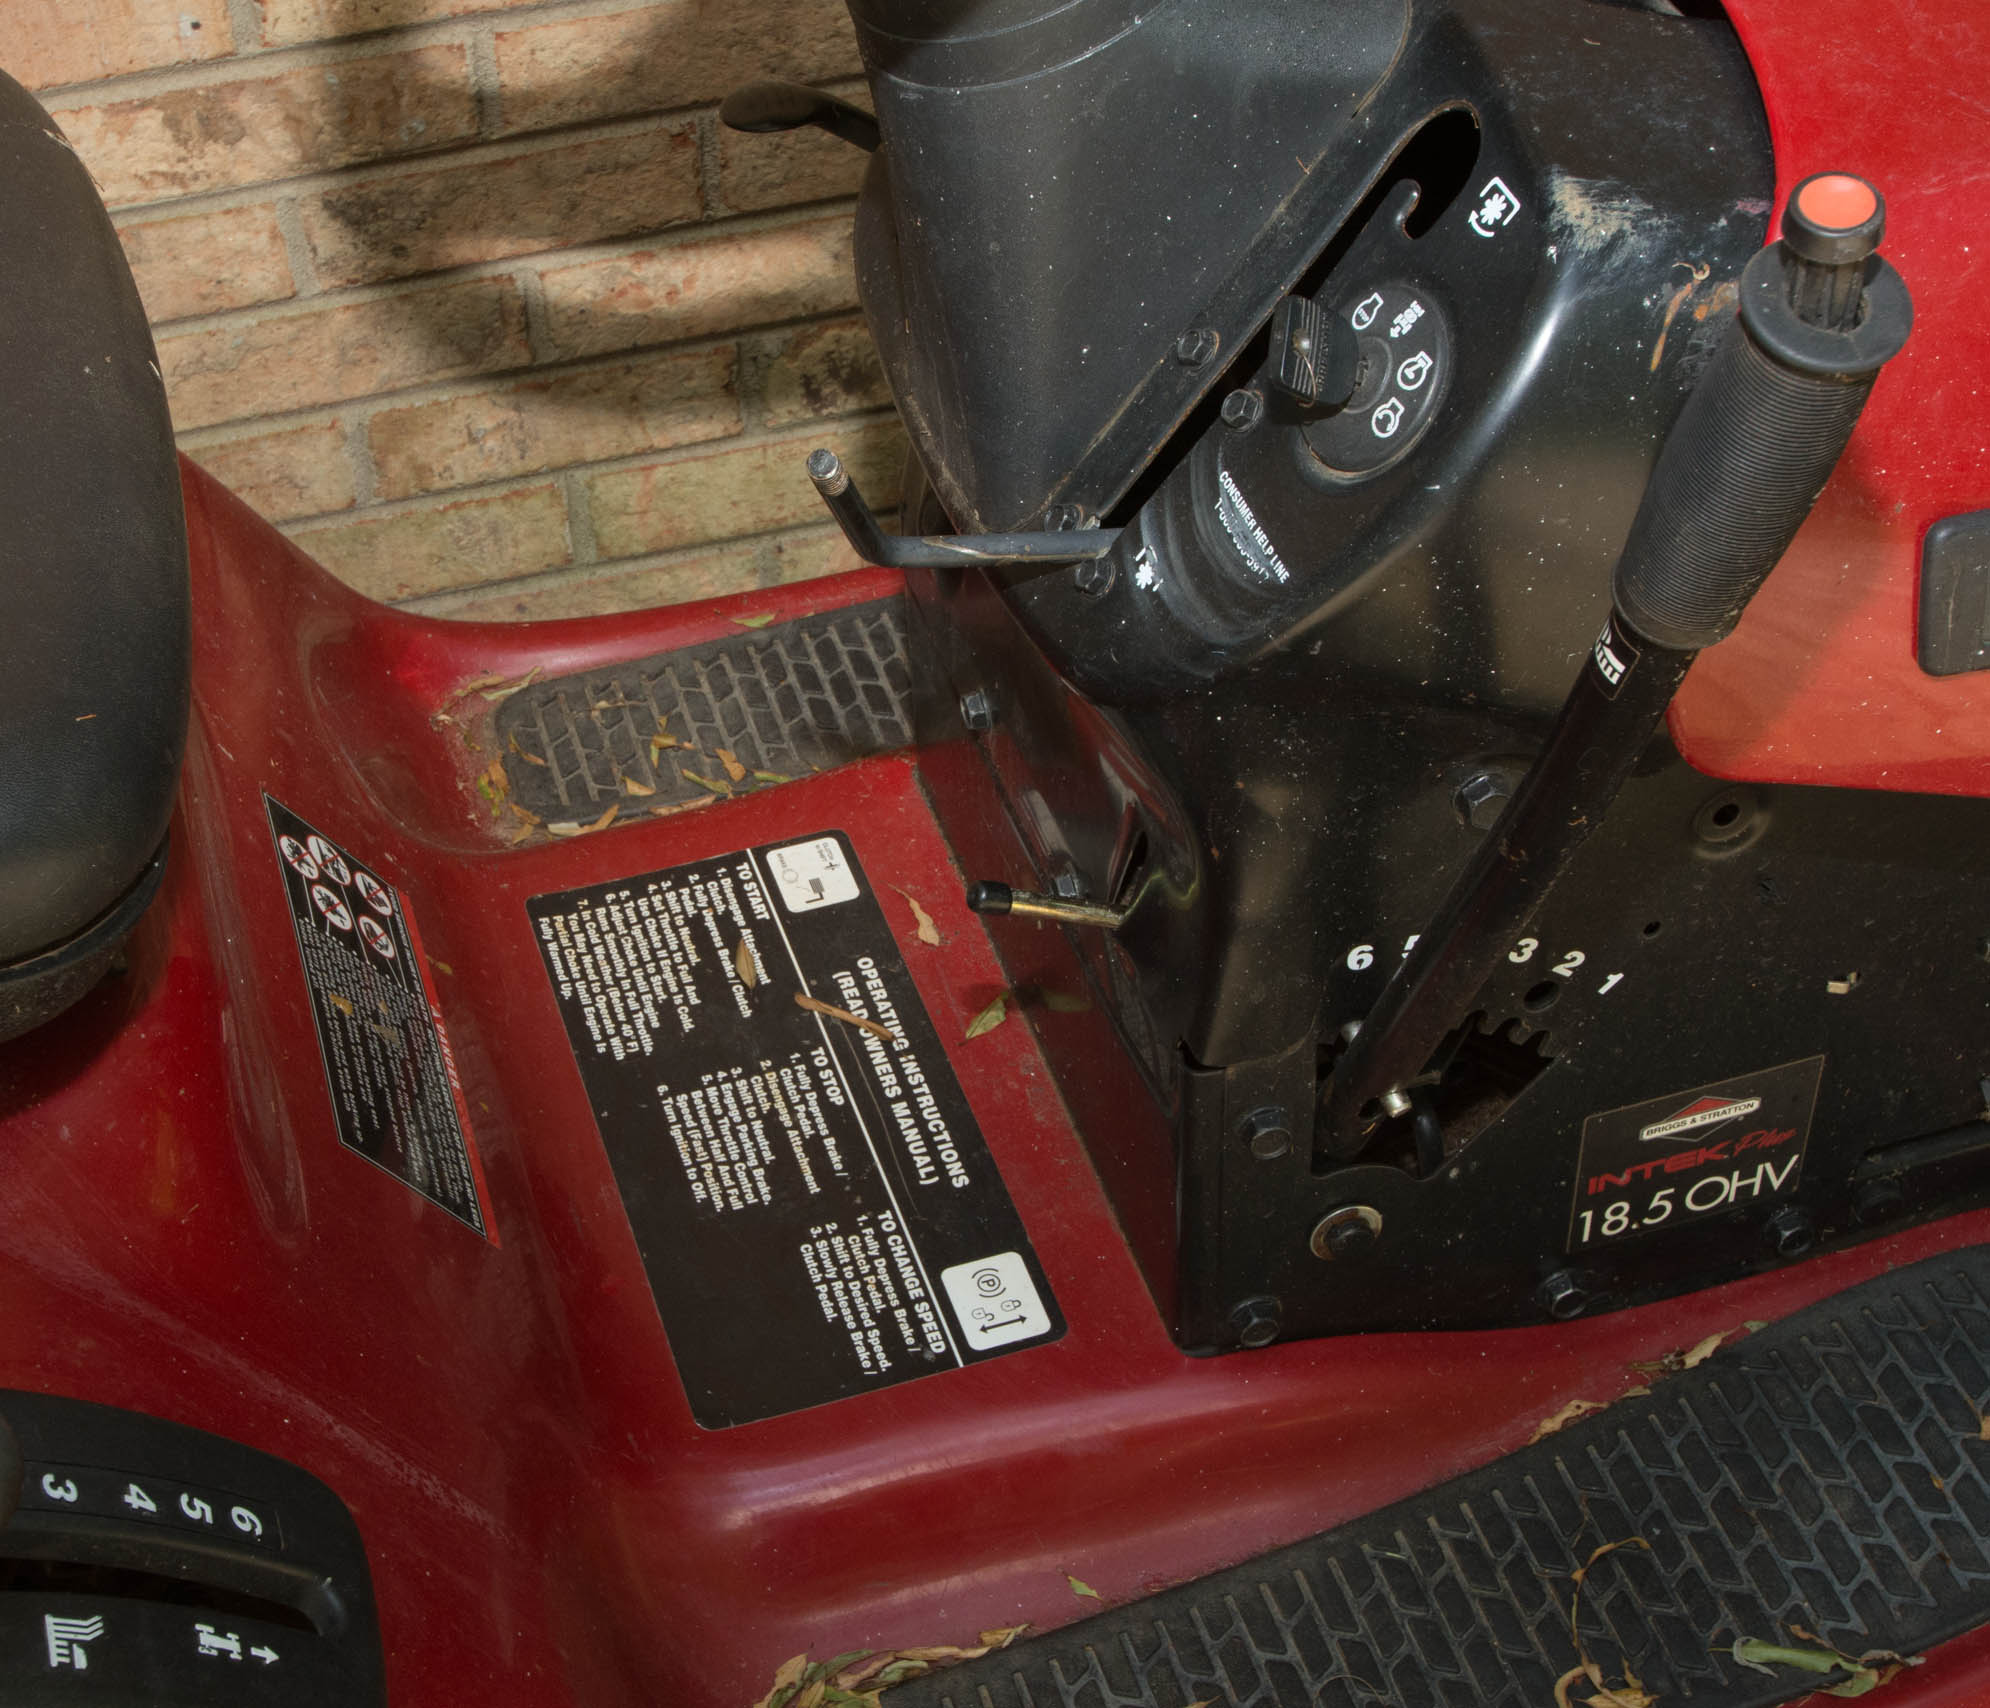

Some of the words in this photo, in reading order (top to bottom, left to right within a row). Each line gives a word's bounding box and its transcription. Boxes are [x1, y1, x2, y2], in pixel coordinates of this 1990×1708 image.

[1219, 471, 1257, 530] CONSUMER
[1253, 526, 1274, 555] HELP
[1270, 554, 1290, 584] LINE
[660, 880, 671, 890] 3.
[688, 873, 699, 883] 2.
[716, 867, 726, 877] 1.
[735, 861, 752, 880] TO
[605, 893, 616, 903] 6.
[618, 890, 630, 900] 5.
[647, 884, 657, 893] 4.
[650, 894, 665, 911] Set
[664, 890, 681, 914] Shift
[678, 887, 697, 917] Pedal.
[692, 884, 708, 907] Fully
[706, 880, 726, 915] Clutch.
[719, 877, 745, 926] Disengage
[743, 881, 770, 919] START
[577, 899, 588, 909] 7.
[580, 910, 591, 920] In
[594, 907, 609, 931] Runs
[623, 900, 637, 923] Turn
[636, 897, 650, 916] Use
[567, 912, 579, 932] You
[585, 921, 601, 944] Cold
[608, 905, 628, 935] Adjust
[644, 917, 662, 948] Choke
[657, 911, 679, 950] Throttle
[673, 914, 684, 926] to
[701, 908, 723, 947] Depress
[573, 933, 587, 952] May
[603, 932, 627, 977] Smoothly
[620, 935, 637, 966] Choke
[630, 924, 651, 961] Ignition
[655, 949, 668, 957] If
[672, 951, 682, 963] to
[678, 926, 700, 966] Neutral.
[740, 928, 771, 984] Attachment
[538, 917, 553, 940] Fully
[546, 941, 569, 981] Warmed
[560, 982, 572, 999] Up.
[581, 954, 599, 980] Need
[593, 944, 613, 985] Weather
[645, 962, 655, 973] to
[717, 948, 735, 978] Brake
[1347, 944, 1374, 971] 6
[1508, 937, 1539, 964] 3
[1551, 950, 1586, 977] 2
[1598, 972, 1625, 995] 1
[552, 915, 572, 946] Partial
[564, 948, 580, 978] Choke
[574, 980, 592, 1004] Until
[583, 1006, 601, 1040] Engine
[595, 1042, 606, 1053] Is
[590, 982, 600, 993] to
[620, 979, 631, 990] In
[632, 968, 649, 992] Until
[649, 974, 667, 1003] Start.
[659, 959, 678, 992] Engine
[677, 964, 693, 983] Full
[605, 987, 626, 1021] (Below
[624, 990, 640, 1010] Full
[672, 994, 683, 1005] Is
[684, 985, 701, 1004] And
[731, 984, 752, 1017] Clutch
[594, 994, 615, 1034] Operate
[640, 993, 659, 1028] Engine
[677, 1005, 694, 1032] Cold.
[609, 1035, 625, 1060] With
[626, 1041, 639, 1052] F)
[632, 1011, 653, 1055] Throttle.
[436, 1023, 460, 1089] DANGER
[759, 1059, 771, 1070] 2.
[789, 1052, 800, 1063] 1.
[810, 1046, 828, 1066] TO
[701, 1074, 712, 1085] 5.
[716, 1071, 727, 1081] 4.
[730, 1066, 742, 1078] 3.
[793, 1064, 811, 1089] Fully
[818, 1068, 844, 1105] STOP
[831, 971, 868, 1019] (READ
[890, 1101, 939, 1184] MANUAL)
[856, 956, 909, 1051] OPERATING
[898, 1054, 969, 1187] INSTRUCTIONS
[656, 1084, 668, 1095] 6.
[705, 1086, 722, 1115] Move
[720, 1082, 741, 1122] Engage
[735, 1078, 753, 1105] Shift
[750, 1075, 771, 1113] Clutch.
[764, 1071, 792, 1127] Disengage
[779, 1068, 801, 1103] Clutch
[793, 1103, 815, 1138] Pedal.
[661, 1096, 676, 1122] Turn
[745, 1106, 756, 1118] to
[804, 1091, 829, 1136] Depress
[1645, 1119, 1688, 1137] BRIGGS
[1689, 1116, 1698, 1126] &
[1699, 1101, 1755, 1122] STRATTON
[669, 1124, 692, 1166] Ignition
[675, 1093, 697, 1127] Speed
[686, 1129, 709, 1161] (Fast)
[700, 1162, 723, 1212] Position.
[690, 1089, 714, 1138] Between
[708, 1139, 726, 1162] Half
[717, 1165, 735, 1186] And
[726, 1188, 744, 1210] Full
[717, 1116, 740, 1160] Throttle
[735, 1123, 758, 1167] Parking
[750, 1119, 775, 1164] Neutral.
[823, 1136, 842, 1170] Brake
[448, 1111, 457, 1132] CUT
[458, 1151, 468, 1178] ARMS
[464, 1180, 474, 1201] AND
[470, 1202, 481, 1228] LEGS
[686, 1167, 697, 1180] to
[786, 1130, 820, 1194] Attachment
[1587, 1140, 1732, 1195] INTEK
[1732, 1127, 1798, 1158] Plus
[691, 1182, 707, 1202] Off.
[734, 1162, 758, 1203] Control
[752, 1167, 771, 1205] Brake.
[1578, 1187, 1676, 1243] 18.5
[1684, 1154, 1800, 1212] OHV
[809, 1226, 822, 1238] 3.
[825, 1222, 837, 1234] 2.
[856, 1214, 868, 1226] 1.
[830, 1235, 850, 1264] Shift
[861, 1227, 879, 1255] Fully
[815, 1239, 837, 1278] Slowly
[842, 1265, 853, 1278] to
[799, 1243, 822, 1282] Clutch
[815, 1283, 837, 1322] Pedal.
[847, 1235, 870, 1274] Clutch
[863, 1275, 886, 1313] Pedal.
[873, 1257, 899, 1306] Depress
[877, 1209, 896, 1232] TO
[887, 1234, 924, 1299] CHANGE
[914, 1301, 945, 1353] SPEED
[830, 1280, 856, 1329] Release
[848, 1280, 875, 1327] Desired
[893, 1308, 914, 1344] Brake
[850, 1331, 871, 1368] Brake
[867, 1328, 891, 1371] Speed.
[42, 1473, 78, 1503] 3
[123, 1482, 157, 1513] 4
[179, 1492, 214, 1525] 5
[230, 1505, 263, 1537] 6
